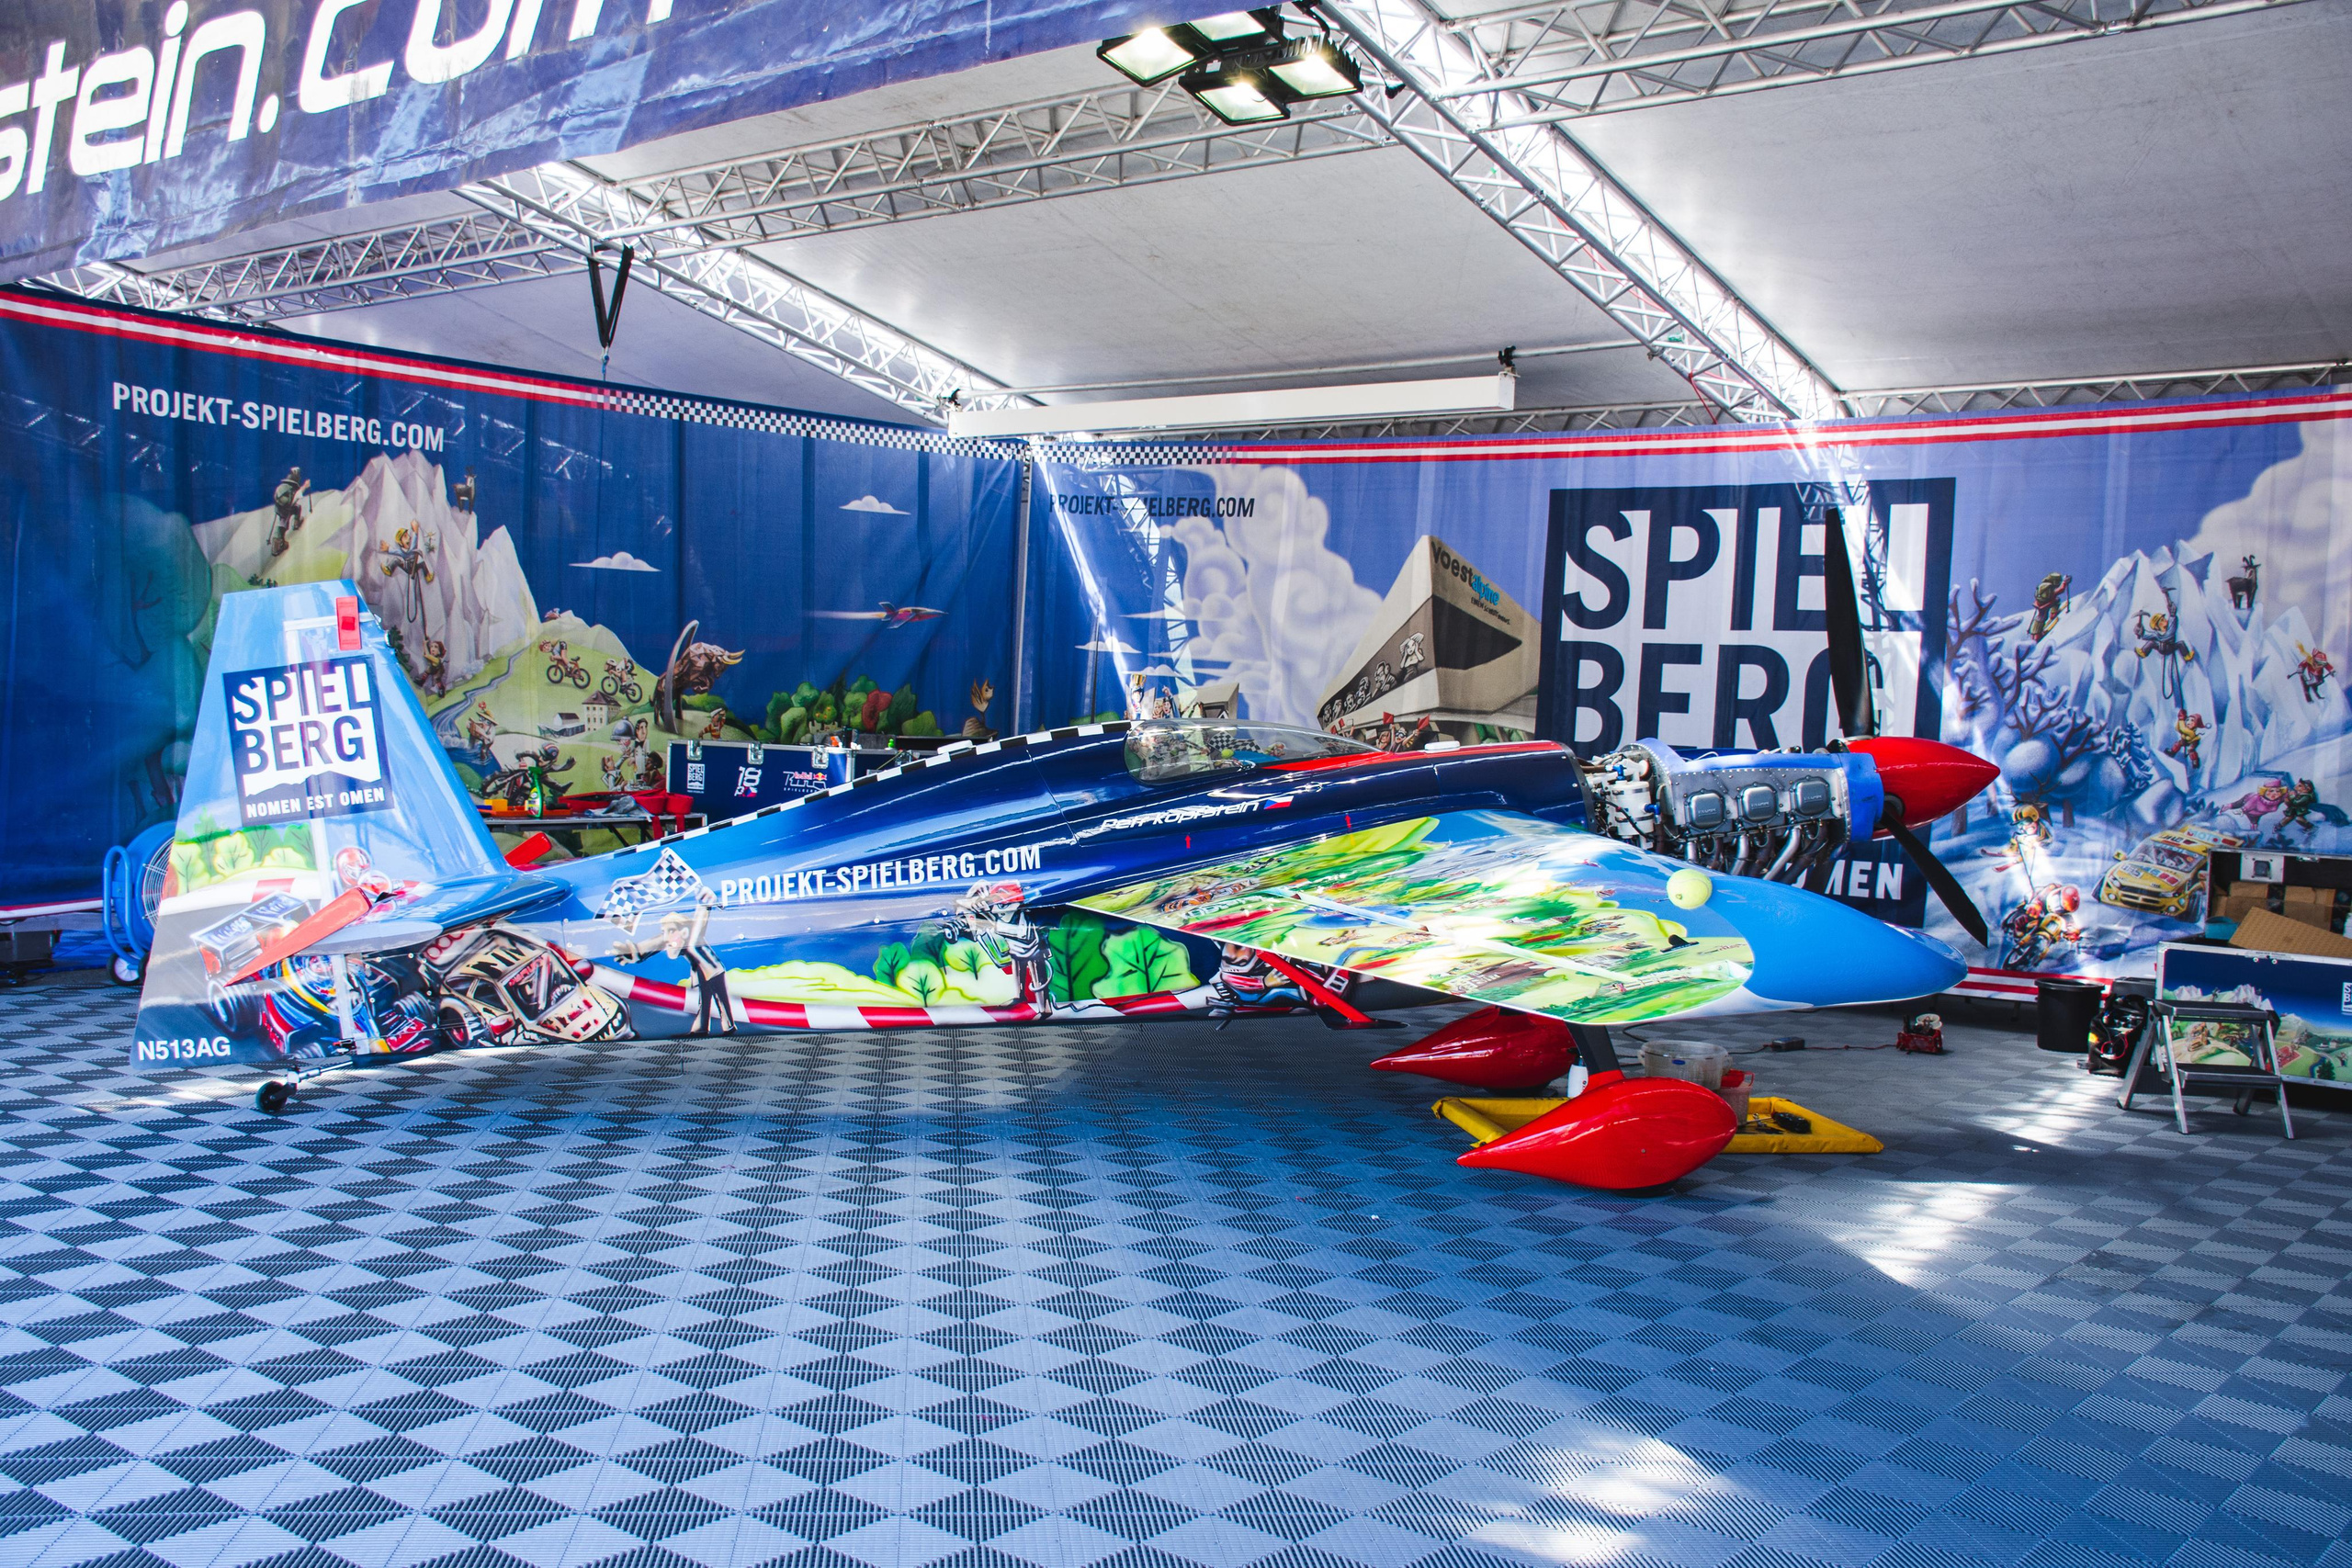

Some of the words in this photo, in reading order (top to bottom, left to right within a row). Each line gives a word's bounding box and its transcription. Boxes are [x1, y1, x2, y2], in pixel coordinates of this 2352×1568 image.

[113, 382, 445, 453] PROJEKT-SPIELBERG.COM
[1049, 493, 1255, 518] PROJEKT-ELBERG.COM
[232, 662, 373, 725] SPIEL
[234, 715, 367, 775] BERG
[245, 798, 301, 818] NOMEN
[307, 794, 334, 811] EST
[339, 787, 386, 807] OMEN
[721, 844, 1042, 907] PROJEKT-SPIELBERG.COM
[138, 1036, 232, 1061] N513AG
